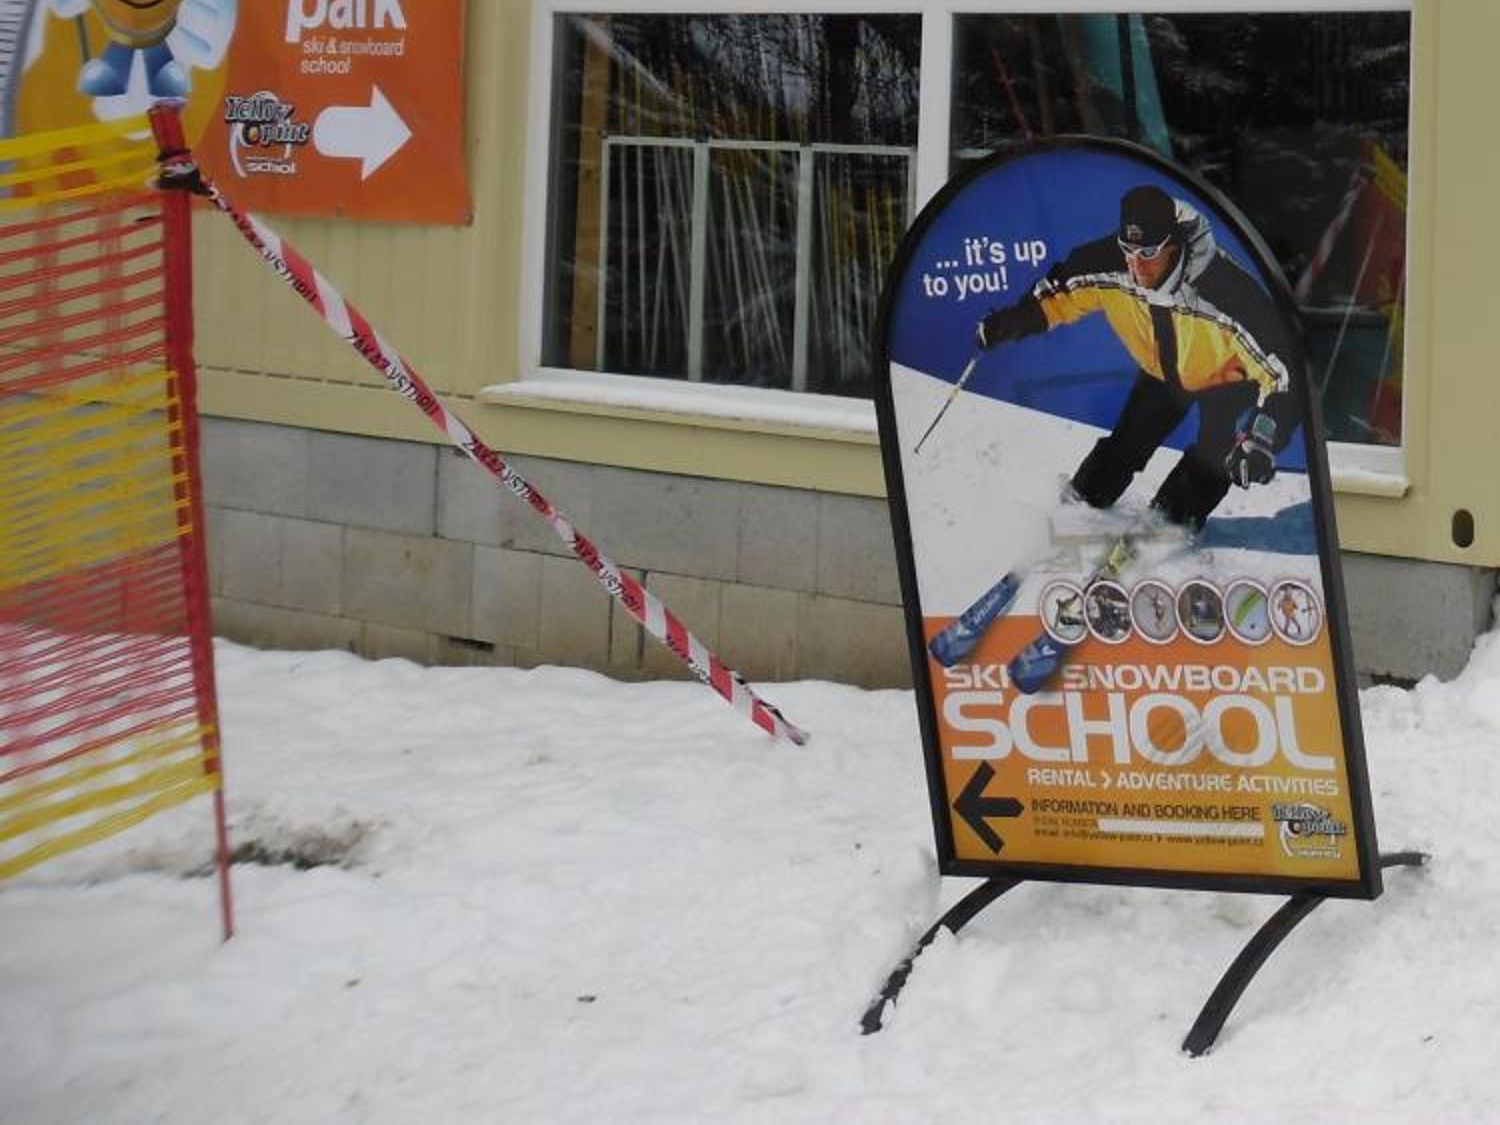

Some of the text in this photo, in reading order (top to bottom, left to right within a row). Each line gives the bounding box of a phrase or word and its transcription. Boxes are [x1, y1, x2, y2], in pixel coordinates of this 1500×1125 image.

[300, 57, 351, 75] school
[964, 236, 1006, 266] it's
[1013, 239, 1048, 267] up
[923, 266, 1009, 302] to you!
[1062, 663, 1325, 694] SNOWBOARD
[943, 690, 1337, 771] SCHOOL
[1027, 768, 1339, 796] RENTAL ADVENTURE ACTIVITIES
[1031, 799, 1262, 821] INFORMATION AND BOOKING HERE
